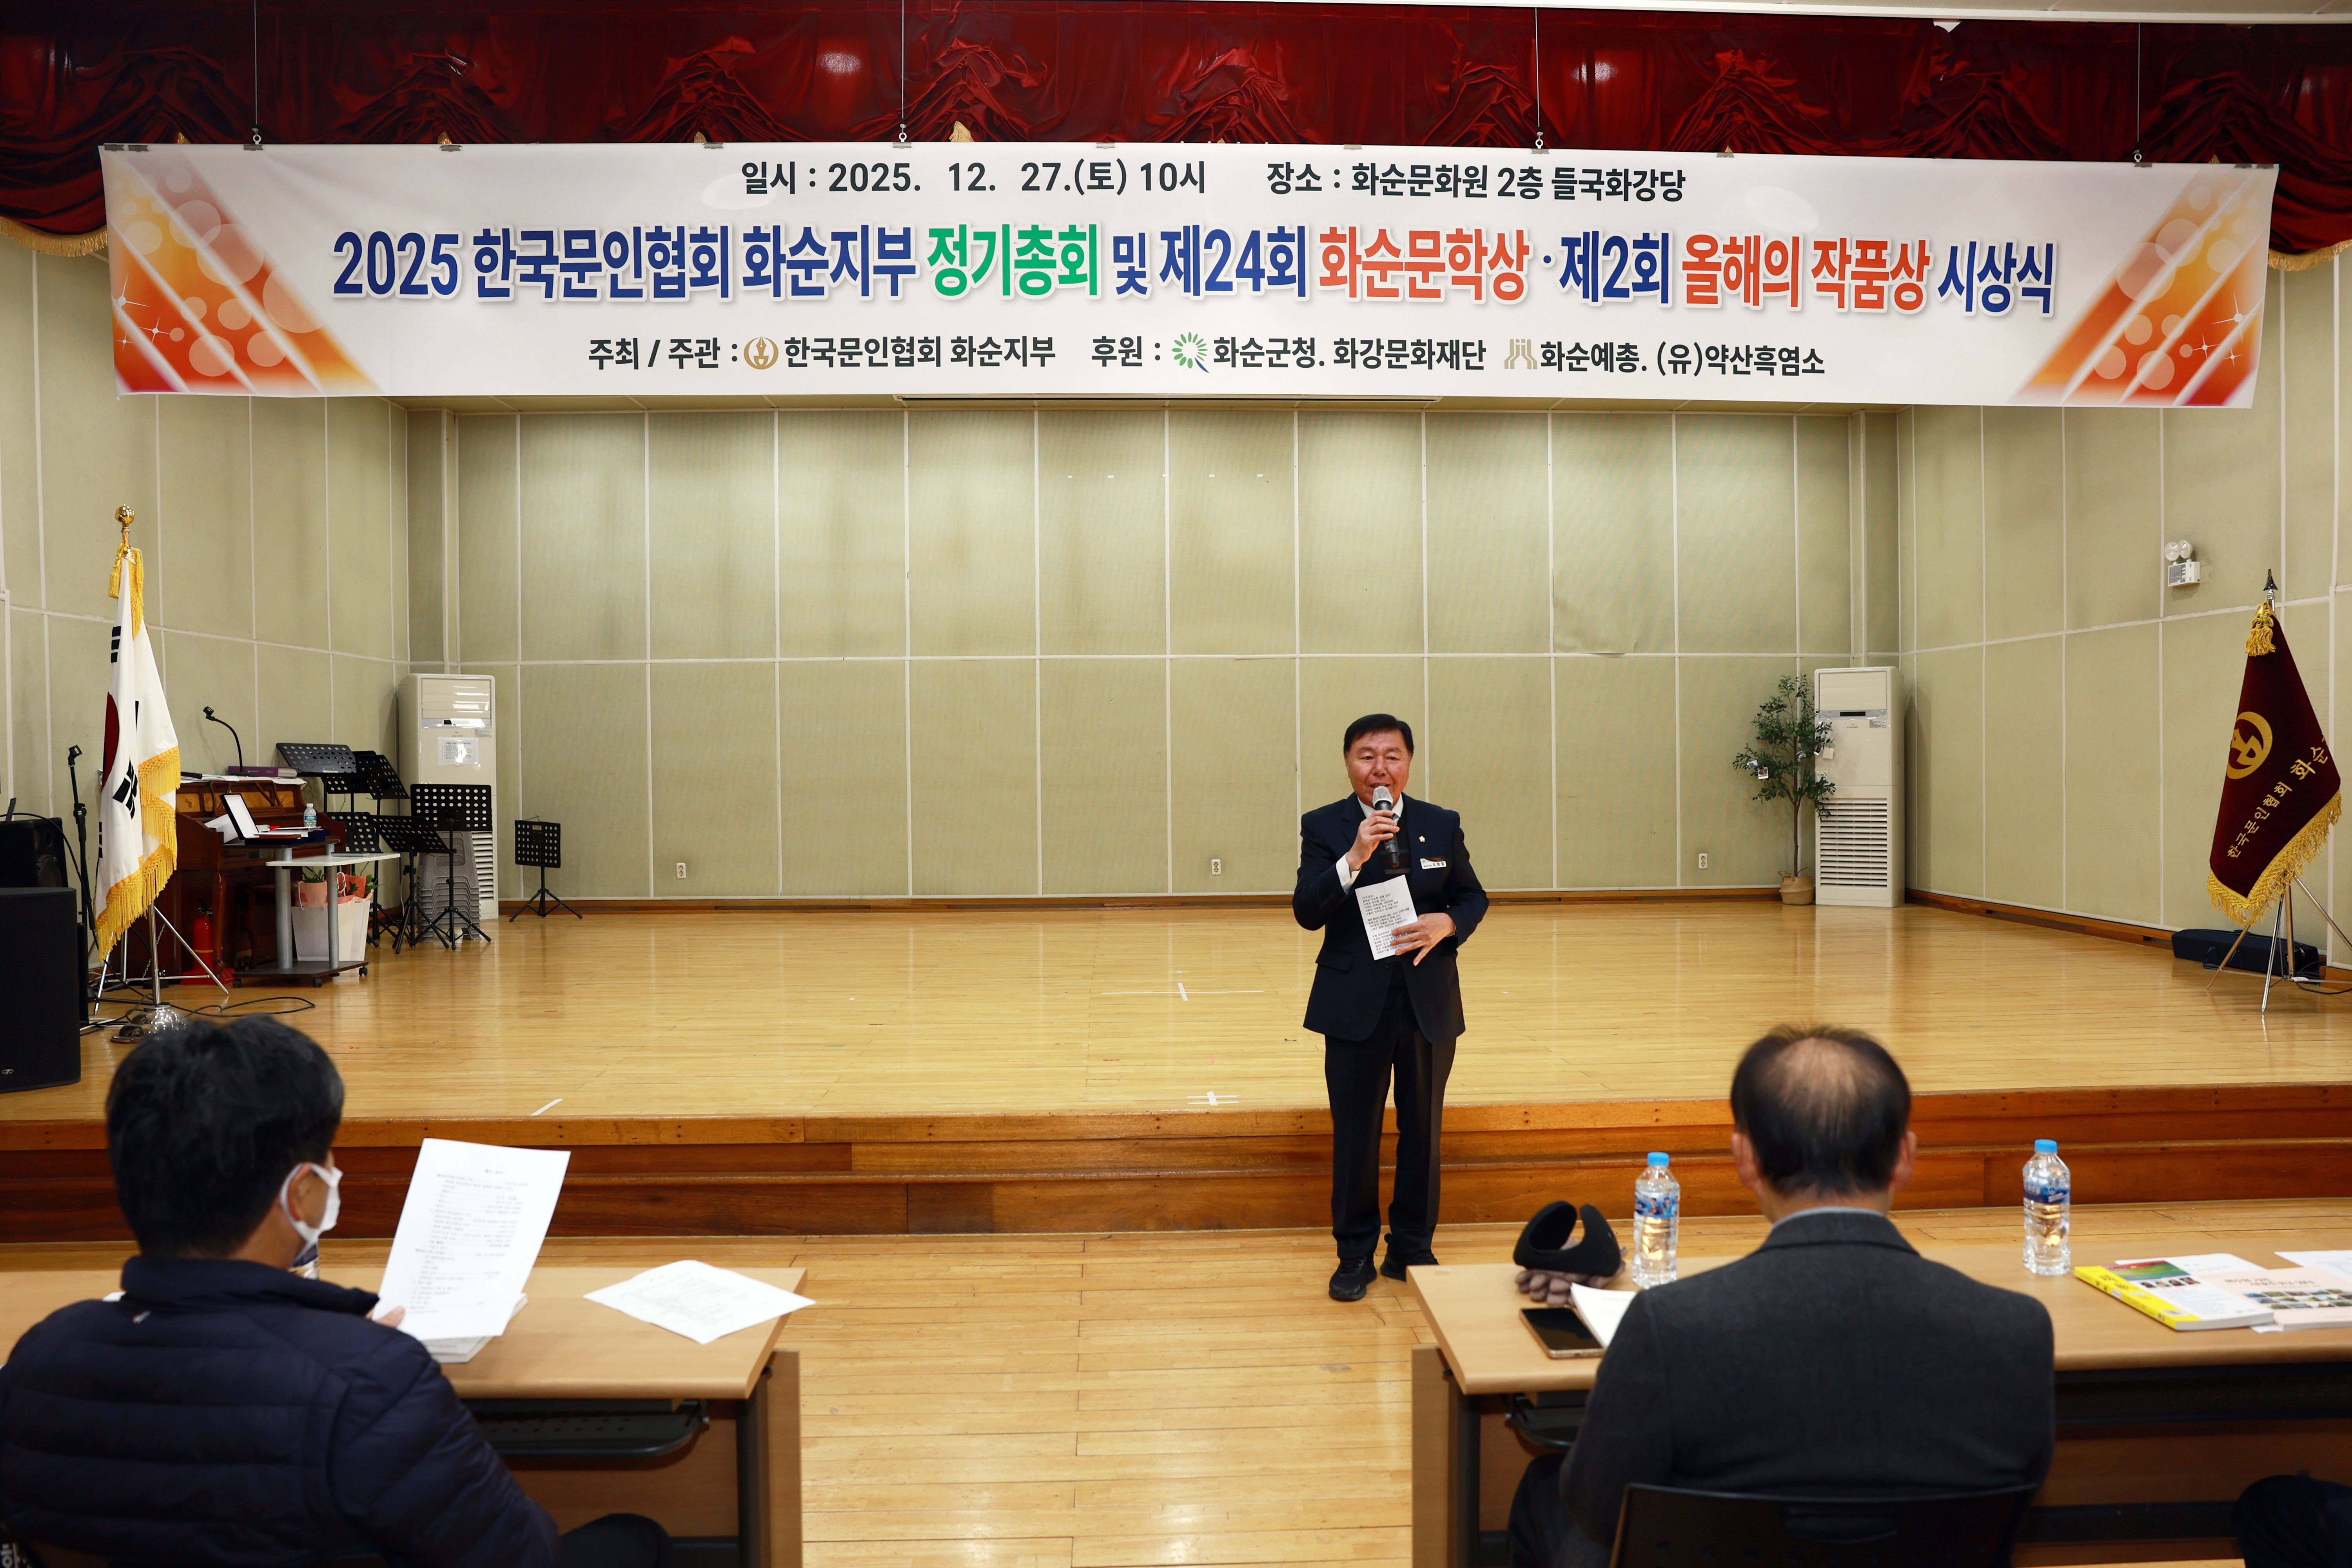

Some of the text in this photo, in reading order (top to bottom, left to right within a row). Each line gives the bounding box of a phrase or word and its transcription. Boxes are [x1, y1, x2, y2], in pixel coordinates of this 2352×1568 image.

[742, 161, 795, 194] 일시
[829, 162, 920, 191] 2025.
[949, 162, 995, 191] 12.
[1021, 158, 1127, 196] 27.(토)
[1141, 161, 1204, 194] 10시
[1267, 162, 1322, 194] 장소
[1352, 163, 1487, 198] 화순문화원
[1498, 166, 1543, 200] 2층
[1551, 167, 1686, 202] 들국화강당
[334, 231, 459, 295] 2025
[473, 225, 729, 298] 한국문인협회
[743, 225, 916, 297] 화순지부
[927, 227, 1097, 296] 정기총회
[1113, 232, 1147, 295] 및
[1160, 229, 1305, 297] 제24회
[1320, 231, 1529, 300] 화순문학상
[1559, 234, 1669, 304] 제2회
[1682, 235, 1799, 307] 올해의
[1811, 238, 1930, 310] 작품상
[1938, 241, 2053, 313] 시상식
[589, 338, 639, 370] 주최
[668, 337, 720, 369] 주관
[784, 336, 941, 367] 한국문인협회
[950, 336, 1055, 367] 화순지부
[1092, 337, 1142, 367] 후원
[1214, 337, 1325, 368] 화순군청.
[1334, 338, 1486, 370] 화강문화재단
[1541, 341, 1647, 373] 화순예총.
[1657, 341, 1825, 376] (유)약산흑염소
[2227, 737, 2328, 858] 한국문인협회 화순
